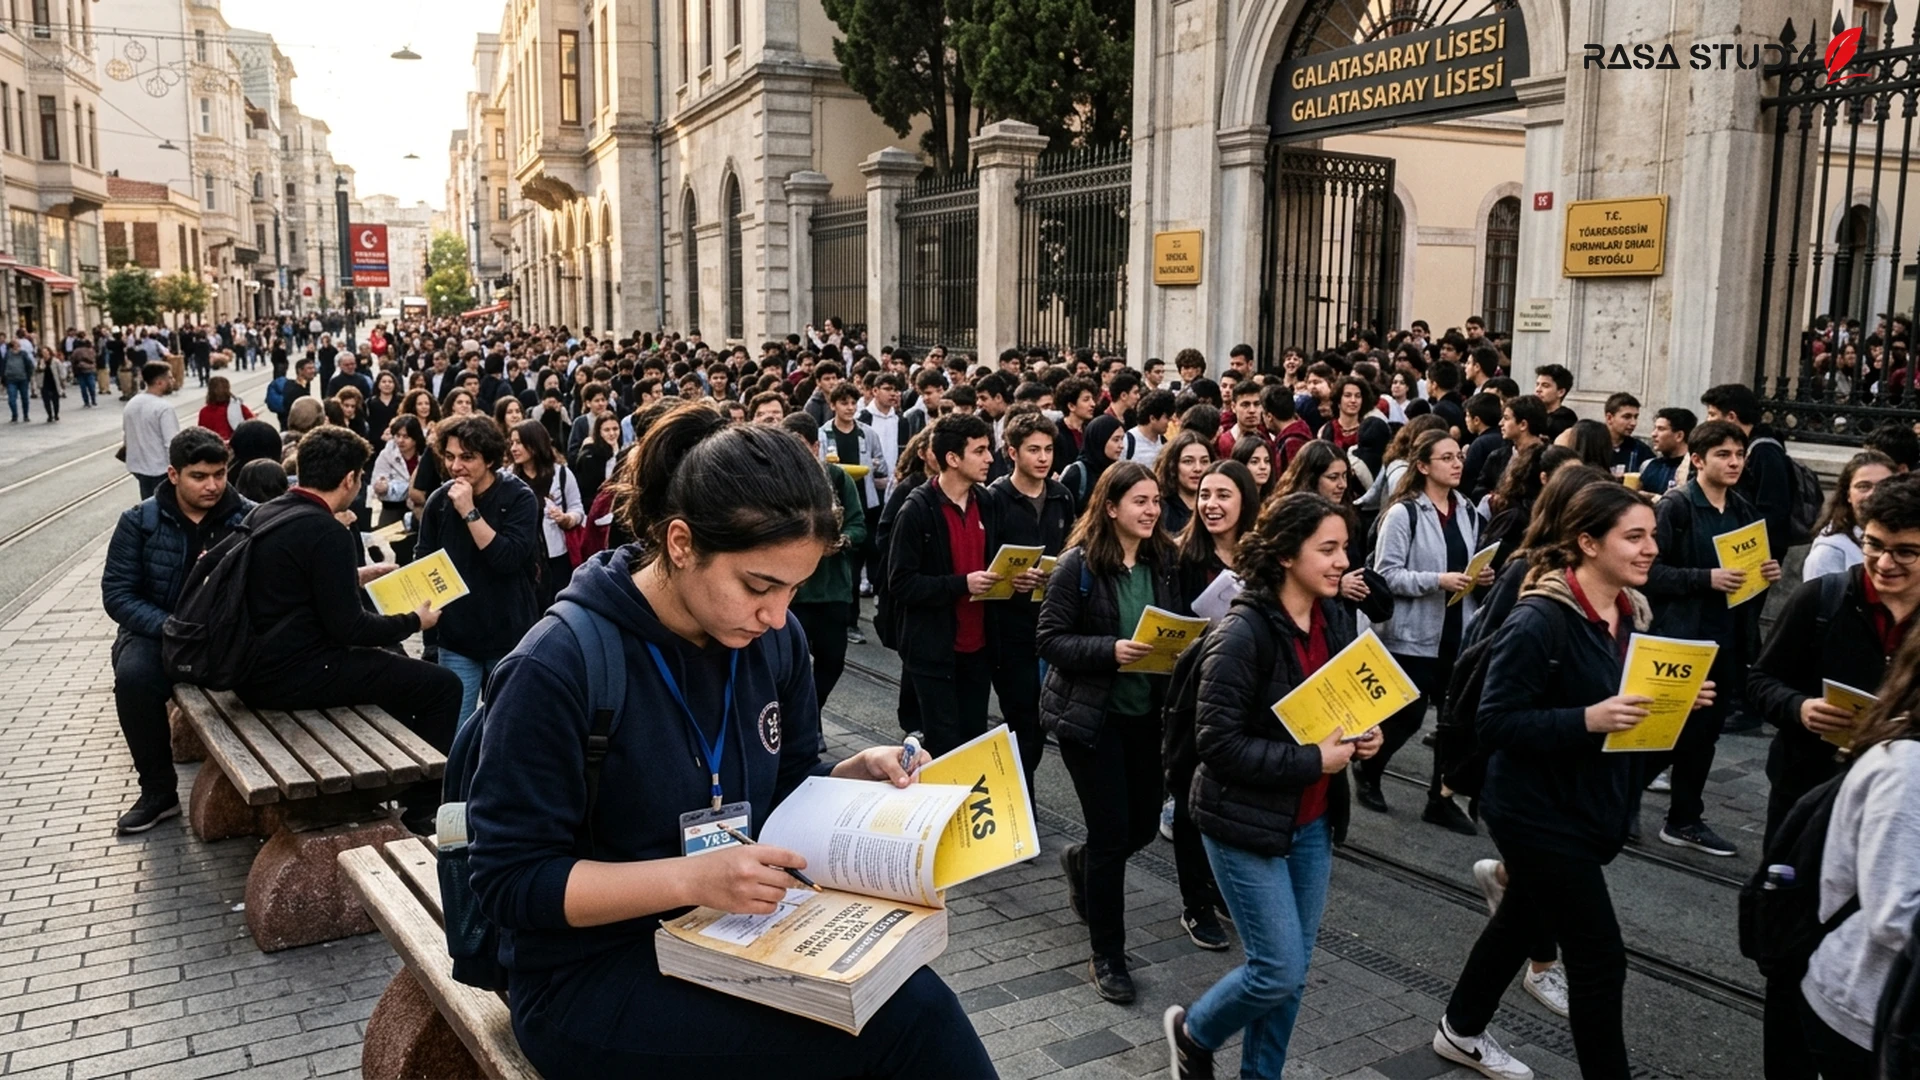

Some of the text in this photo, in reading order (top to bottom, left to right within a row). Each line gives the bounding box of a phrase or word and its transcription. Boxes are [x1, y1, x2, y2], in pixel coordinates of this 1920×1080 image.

[1291, 17, 1506, 90] GALATASARAY LİSESİ
[1291, 56, 1504, 122] GALATASARAY LİSESİ
[1355, 662, 1387, 700] YKS
[1652, 660, 1693, 679] YKS
[970, 774, 996, 840] YKS
